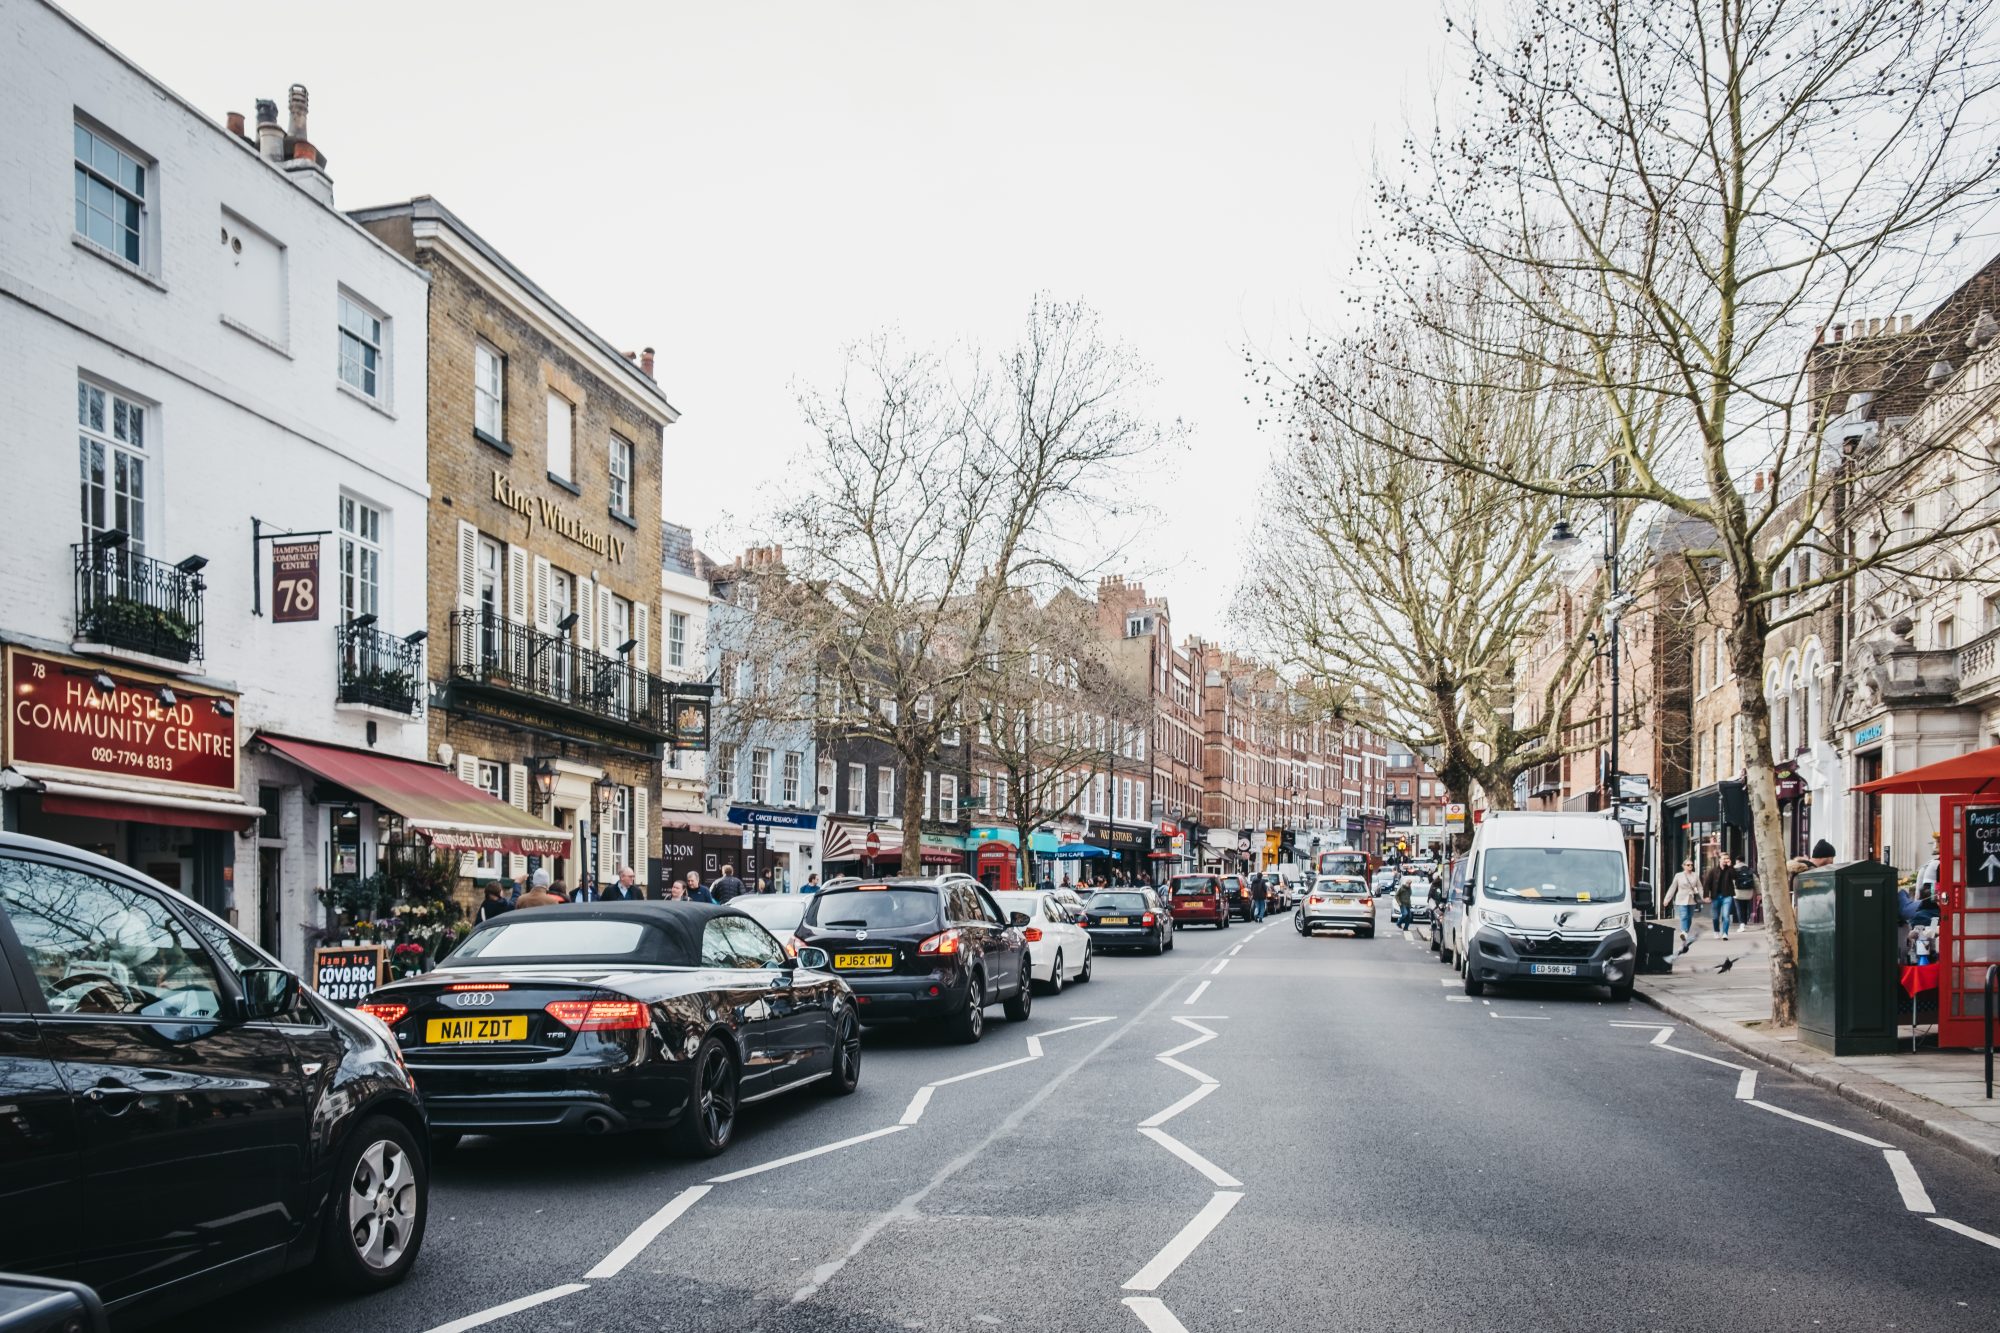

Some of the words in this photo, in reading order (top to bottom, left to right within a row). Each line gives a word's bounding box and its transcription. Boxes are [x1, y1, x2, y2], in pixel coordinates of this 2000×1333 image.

[493, 470, 534, 538] King
[538, 496, 604, 555] William
[608, 534, 626, 564] IV
[273, 552, 318, 562] COMMUNITY
[274, 544, 318, 554] HAMPSTEAD
[281, 562, 310, 570] CENTRE
[277, 578, 314, 612] 78
[31, 663, 46, 680] 78
[67, 681, 193, 726] HAMPSTEAD
[16, 700, 156, 745] COMMUNITY
[164, 726, 232, 758] CENTRE
[92, 747, 143, 768] 020-7794
[147, 755, 172, 772] 8313
[424, 829, 475, 849] Hampstead
[475, 832, 502, 849] Florist
[1100, 829, 1133, 842] WATRSTONES
[839, 956, 866, 966] PJ62
[868, 956, 888, 965] GMV
[478, 1019, 512, 1038] ZDT
